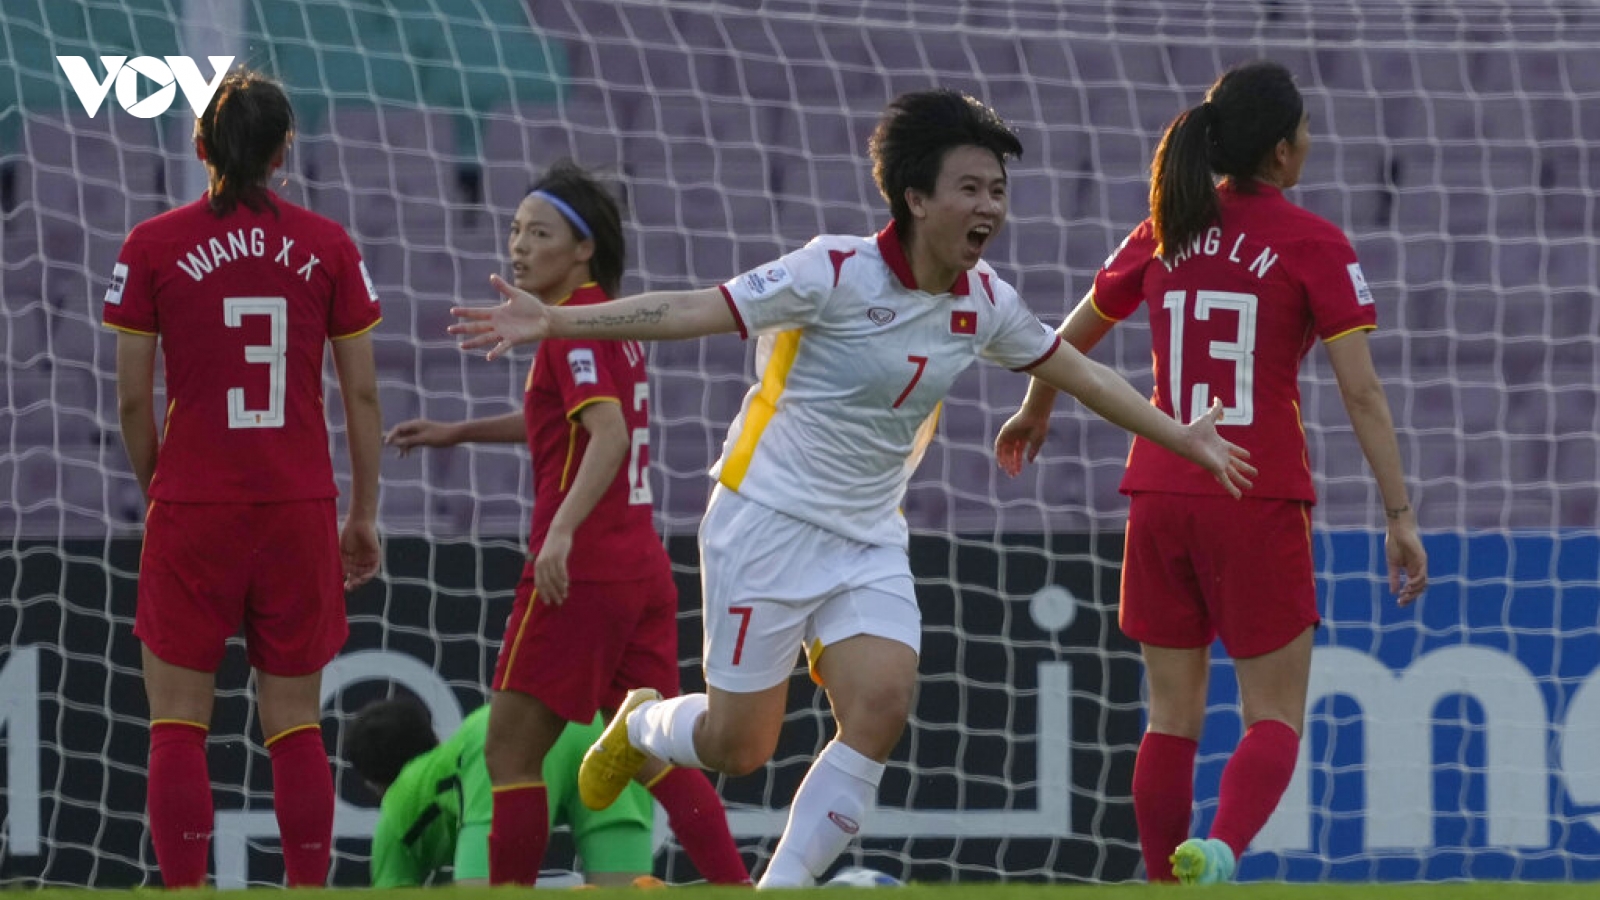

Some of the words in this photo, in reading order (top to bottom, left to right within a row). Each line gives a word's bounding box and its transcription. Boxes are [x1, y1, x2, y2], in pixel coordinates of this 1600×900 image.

[177, 227, 265, 281] WANG
[1155, 226, 1222, 273] ANG
[223, 297, 287, 429] 3
[892, 355, 928, 409] 7
[1163, 289, 1258, 426] 13
[728, 606, 753, 666] 7
